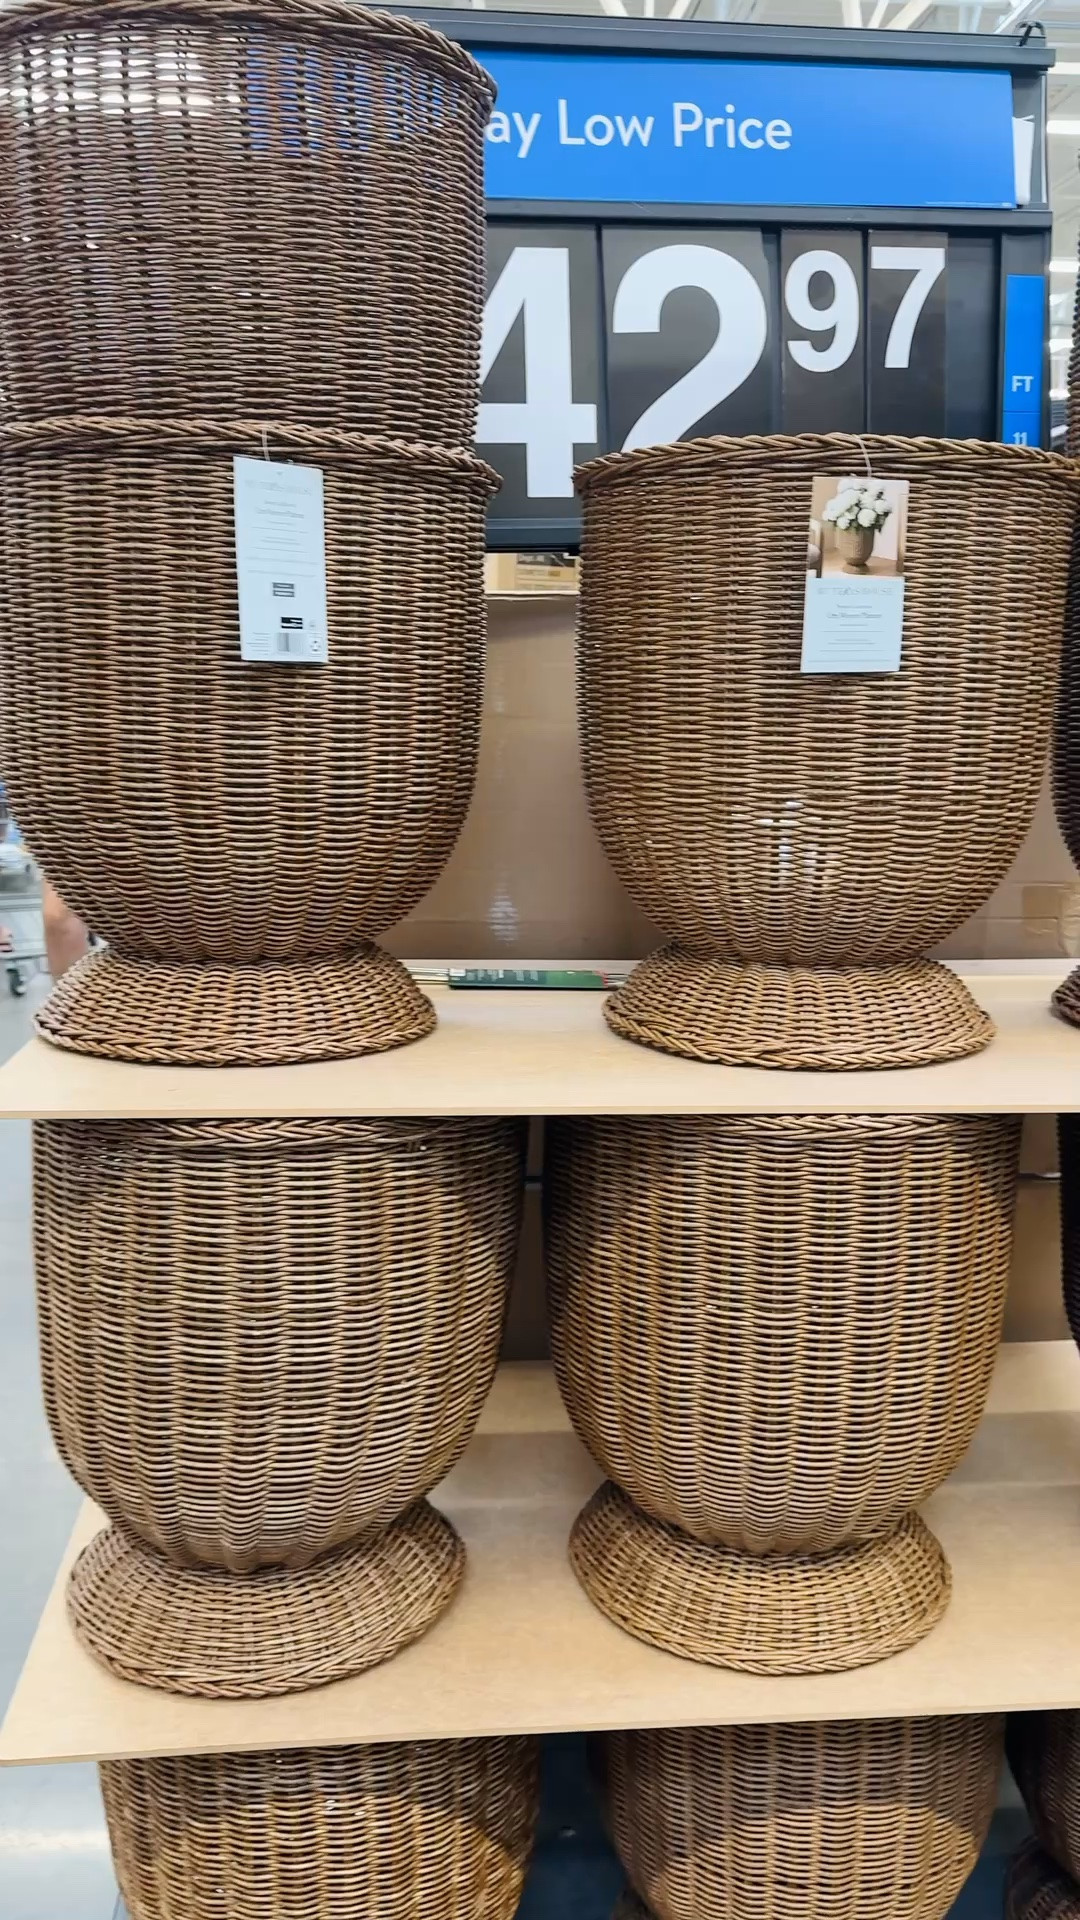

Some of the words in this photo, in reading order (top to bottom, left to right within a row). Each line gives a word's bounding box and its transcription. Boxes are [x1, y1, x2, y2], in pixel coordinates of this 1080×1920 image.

[558, 98, 655, 147] Low
[672, 102, 793, 150] Price
[1011, 375, 1035, 393] FT
